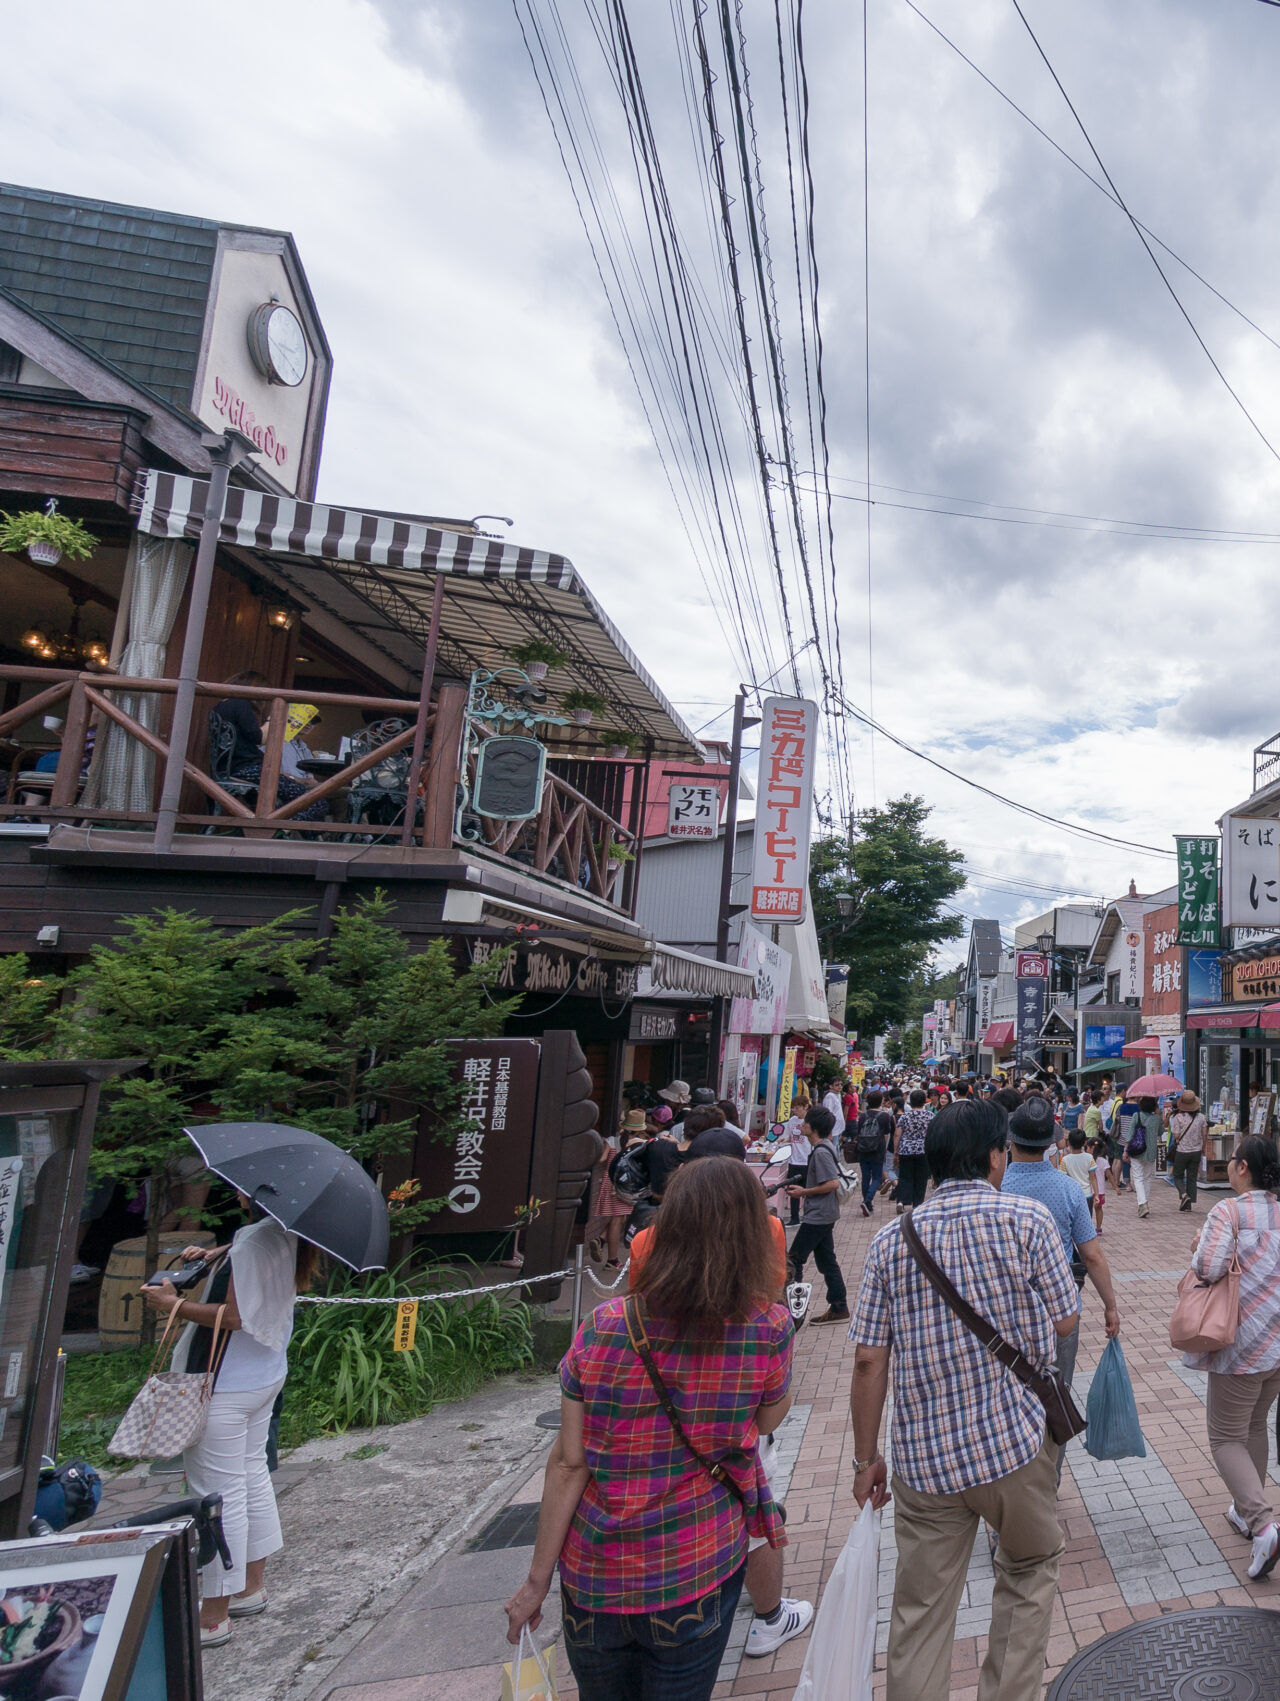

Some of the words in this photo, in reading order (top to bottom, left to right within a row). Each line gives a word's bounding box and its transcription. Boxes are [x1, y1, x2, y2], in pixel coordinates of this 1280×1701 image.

[670, 825, 713, 836] 軽井沢名物
[756, 890, 800, 912] 軽井沢店
[1180, 929, 1216, 944] にし川
[472, 937, 518, 988] 軽沢
[1236, 964, 1254, 980] SUGI
[491, 1057, 511, 1131] 日本基督教団
